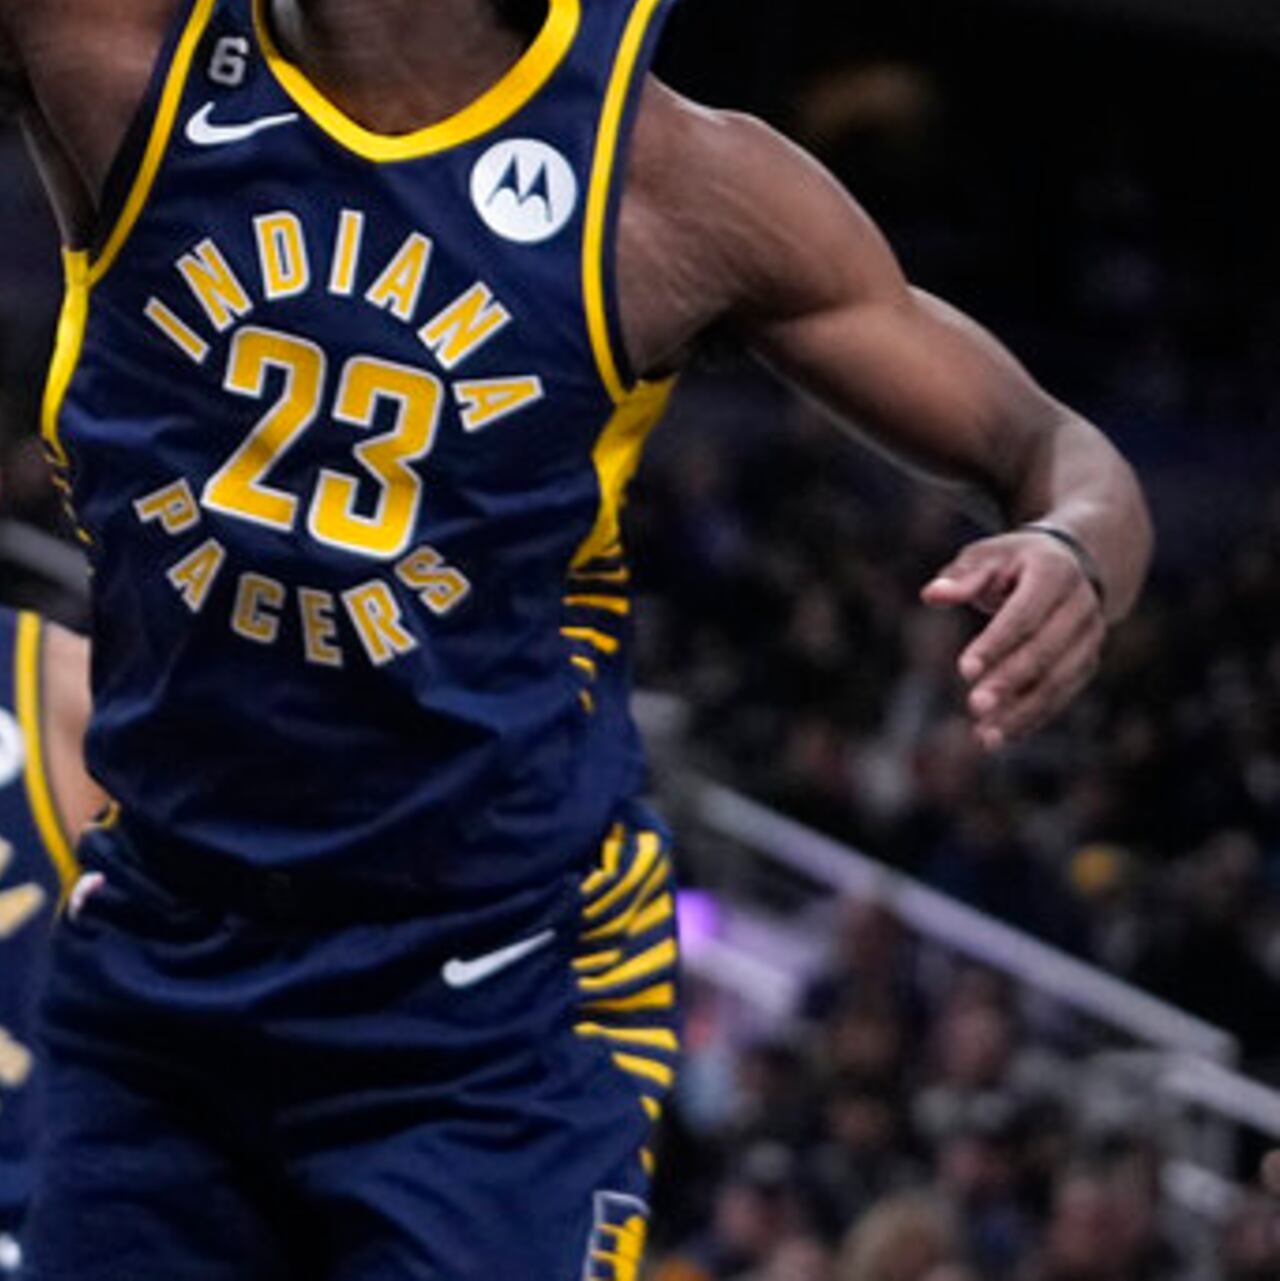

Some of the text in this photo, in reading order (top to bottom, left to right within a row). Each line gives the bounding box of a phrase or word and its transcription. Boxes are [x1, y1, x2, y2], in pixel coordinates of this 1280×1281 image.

[207, 35, 250, 87] 6
[143, 208, 544, 433] INDIANA
[200, 323, 443, 559] 23
[134, 477, 472, 668] PACERS
